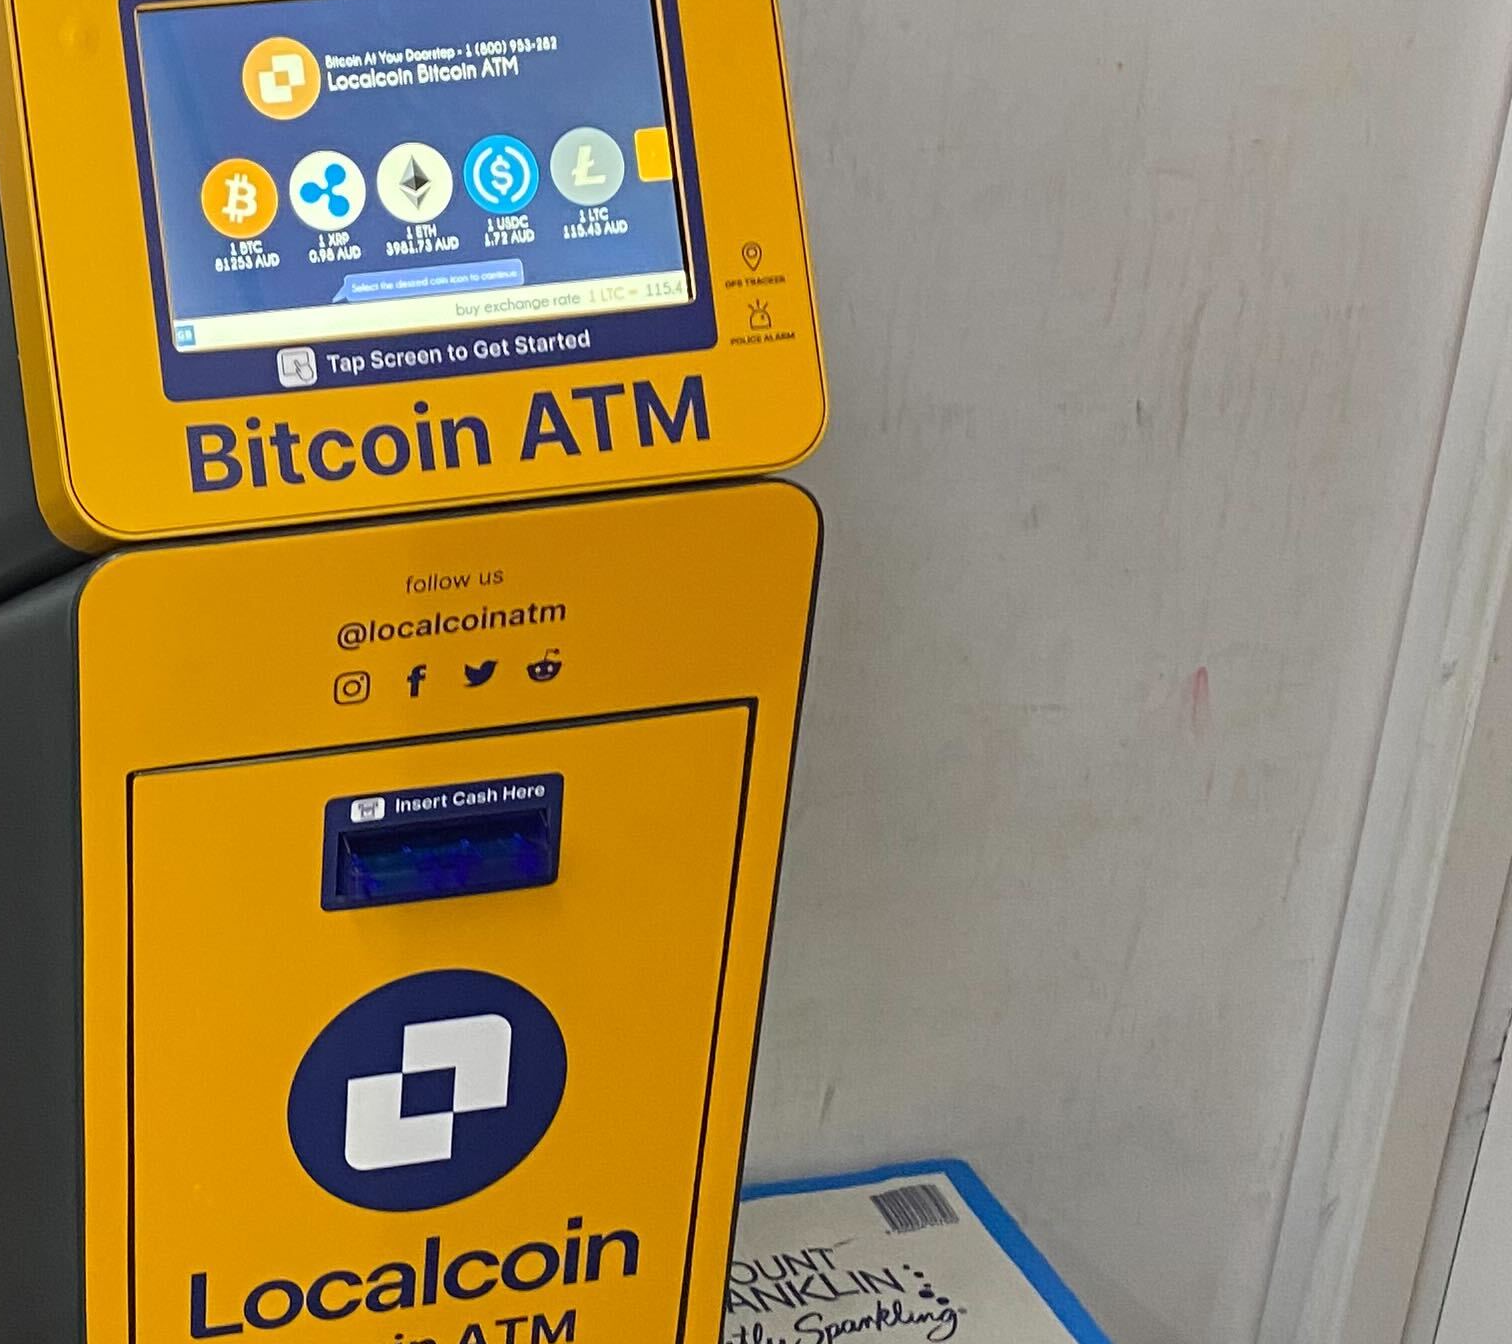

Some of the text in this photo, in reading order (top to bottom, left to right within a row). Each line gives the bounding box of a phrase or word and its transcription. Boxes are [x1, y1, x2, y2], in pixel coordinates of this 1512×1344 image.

[325, 52, 362, 69] Bitcoin
[364, 51, 377, 66] At
[378, 49, 403, 65] Your
[327, 56, 519, 92] Localcoin Bitcoin ATM
[488, 215, 529, 232] 1 USDC
[579, 207, 609, 223] 1 LTC
[406, 224, 437, 240] 1 ETH
[511, 228, 535, 244] AUD
[604, 219, 628, 234] AUD
[230, 240, 263, 256] 1 BTC
[318, 231, 350, 248] 1 XRP
[435, 236, 460, 252] AUD
[255, 252, 280, 269] AUD
[337, 245, 362, 261] AUD
[455, 301, 481, 317] buy
[484, 295, 550, 315] exchange
[553, 292, 582, 307] rate
[600, 286, 625, 303] LTC
[327, 329, 591, 375] Tap Screen to Get Started
[184, 373, 711, 494] Bitcoin ATM
[405, 569, 504, 594] follow us
[336, 601, 567, 651] @localcoinatm
[396, 783, 545, 814] Insert Cash Here
[728, 1248, 835, 1285] OUNT
[189, 1216, 640, 1340] Localcoin
[727, 1268, 906, 1314] ANKLIN
